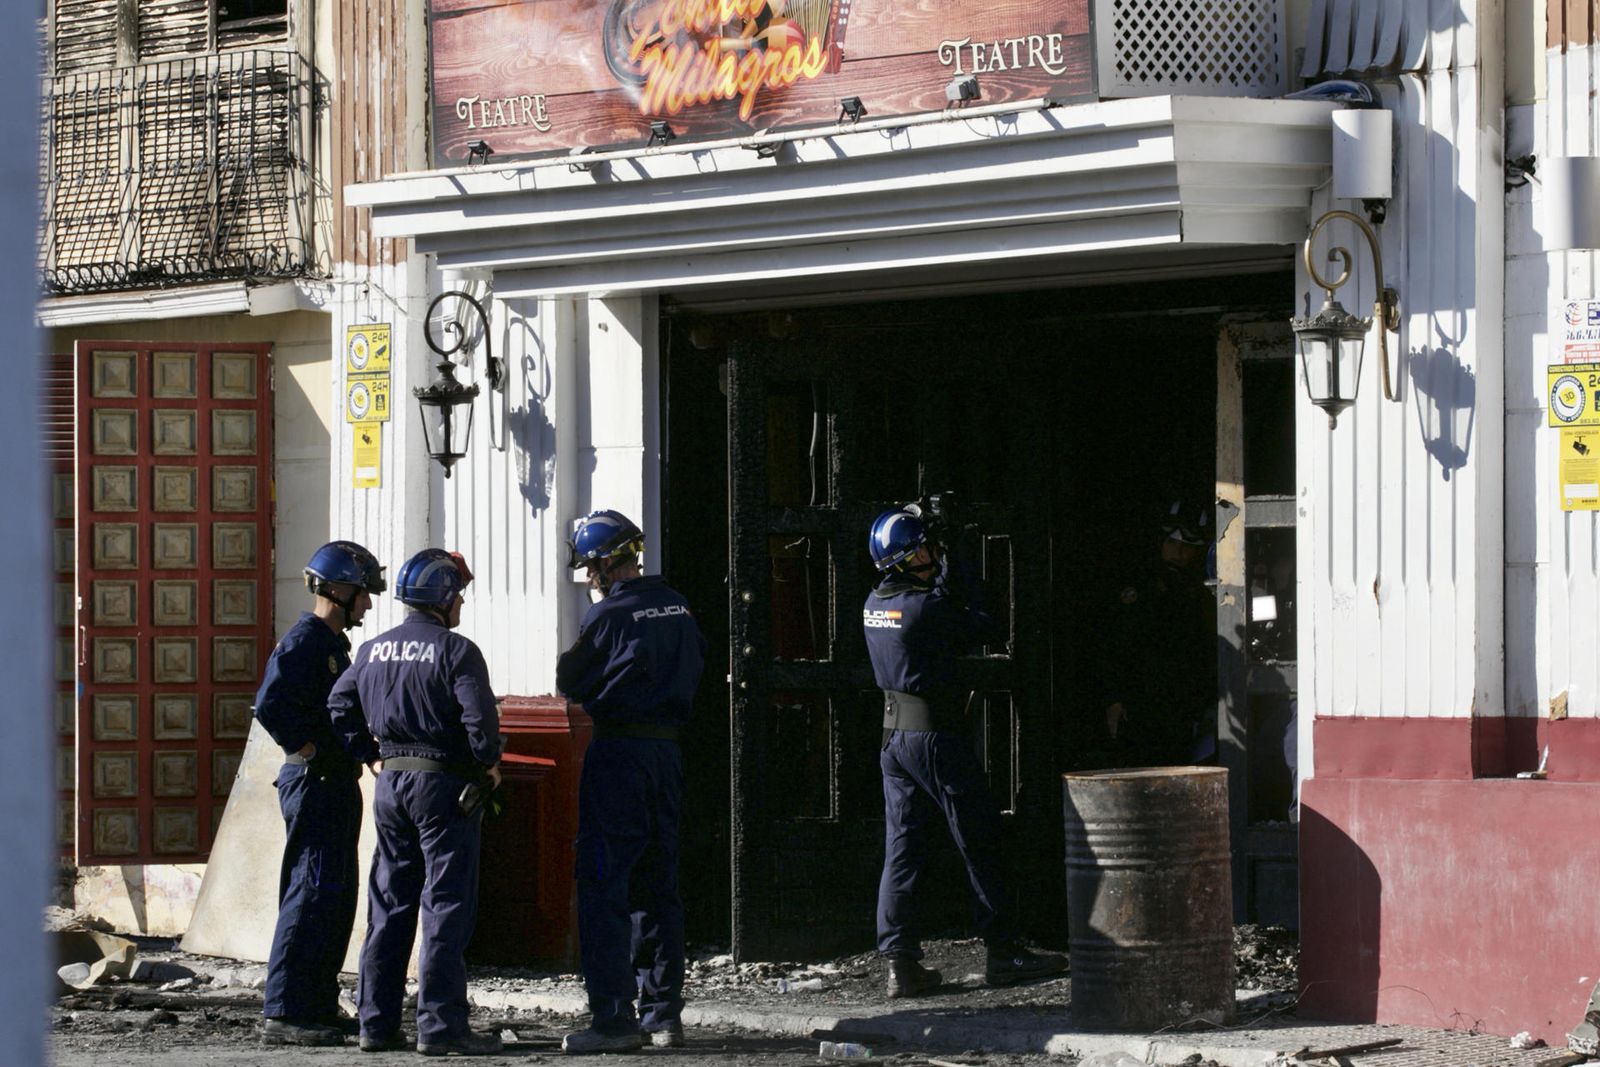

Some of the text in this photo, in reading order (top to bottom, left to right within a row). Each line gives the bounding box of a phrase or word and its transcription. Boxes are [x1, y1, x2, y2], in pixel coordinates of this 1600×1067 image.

[938, 34, 1067, 75] TEATRE
[639, 34, 829, 121] Milagros
[456, 94, 552, 132] TEATRE
[372, 332, 388, 343] 24H
[632, 605, 690, 622] POLICIA
[368, 640, 435, 663] POLICIA
